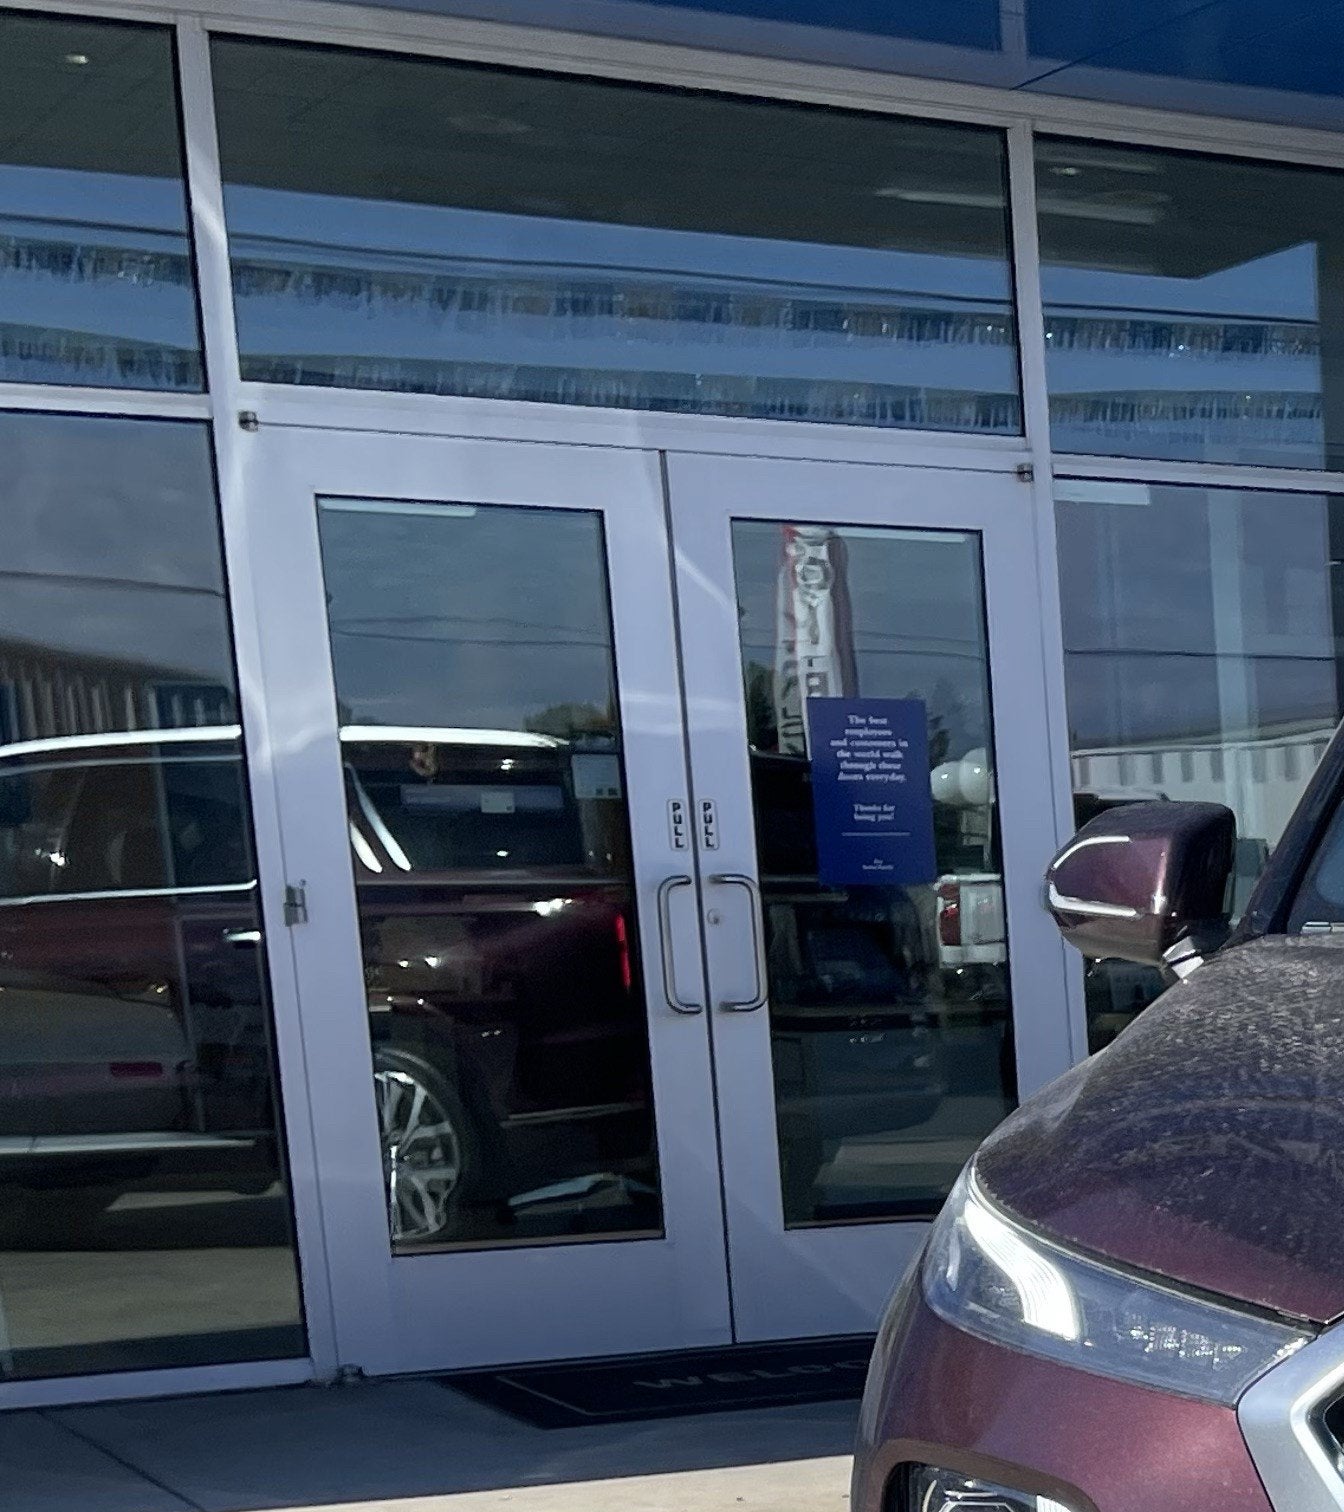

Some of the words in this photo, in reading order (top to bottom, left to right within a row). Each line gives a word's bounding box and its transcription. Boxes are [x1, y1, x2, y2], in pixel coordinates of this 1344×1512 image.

[829, 737, 848, 747] and
[672, 802, 685, 849] PULL
[703, 802, 715, 848] PULL
